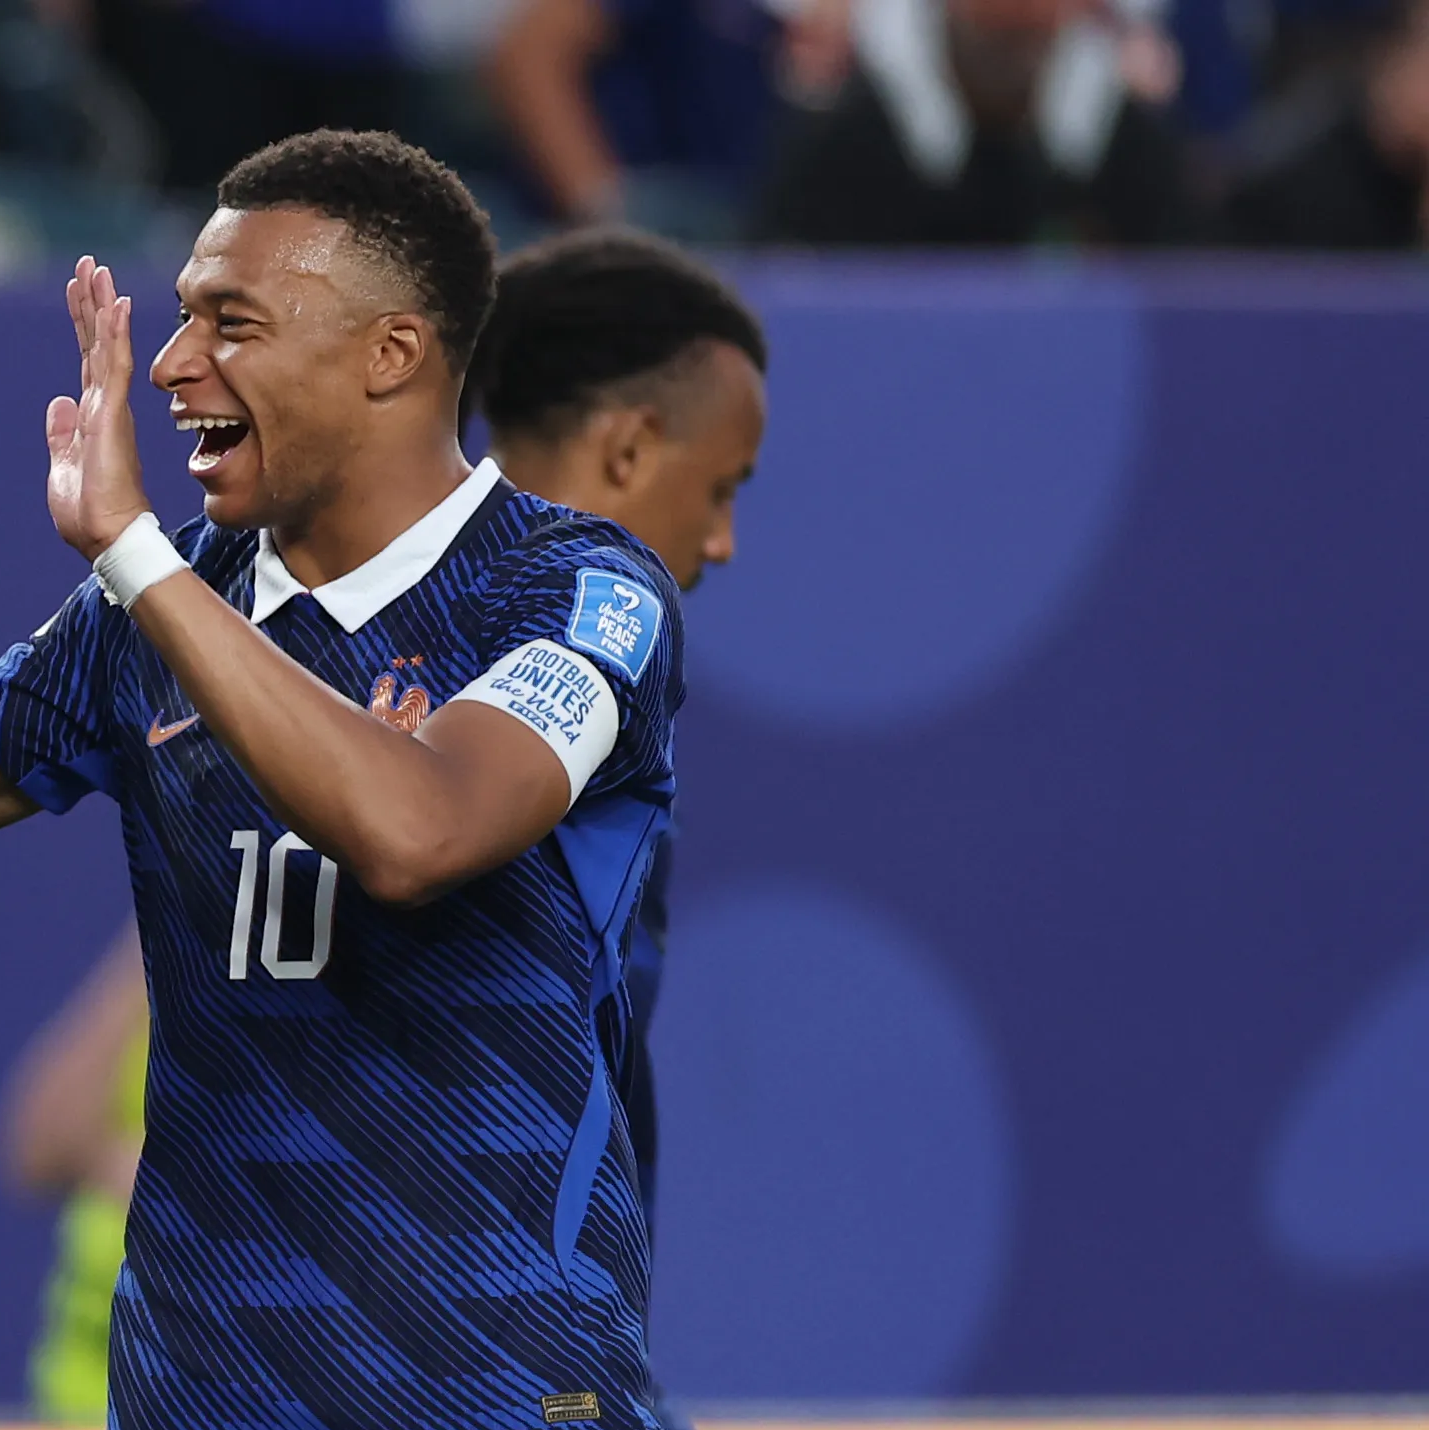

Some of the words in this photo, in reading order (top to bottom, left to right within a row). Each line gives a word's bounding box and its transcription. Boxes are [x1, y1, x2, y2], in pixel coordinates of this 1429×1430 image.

[596, 615, 637, 653] PEACE
[601, 636, 625, 657] FIFA
[508, 662, 590, 725] UNITES
[522, 647, 601, 708] FOOTBALL
[490, 677, 525, 697] the
[526, 691, 581, 746] World
[229, 829, 338, 980] 10
